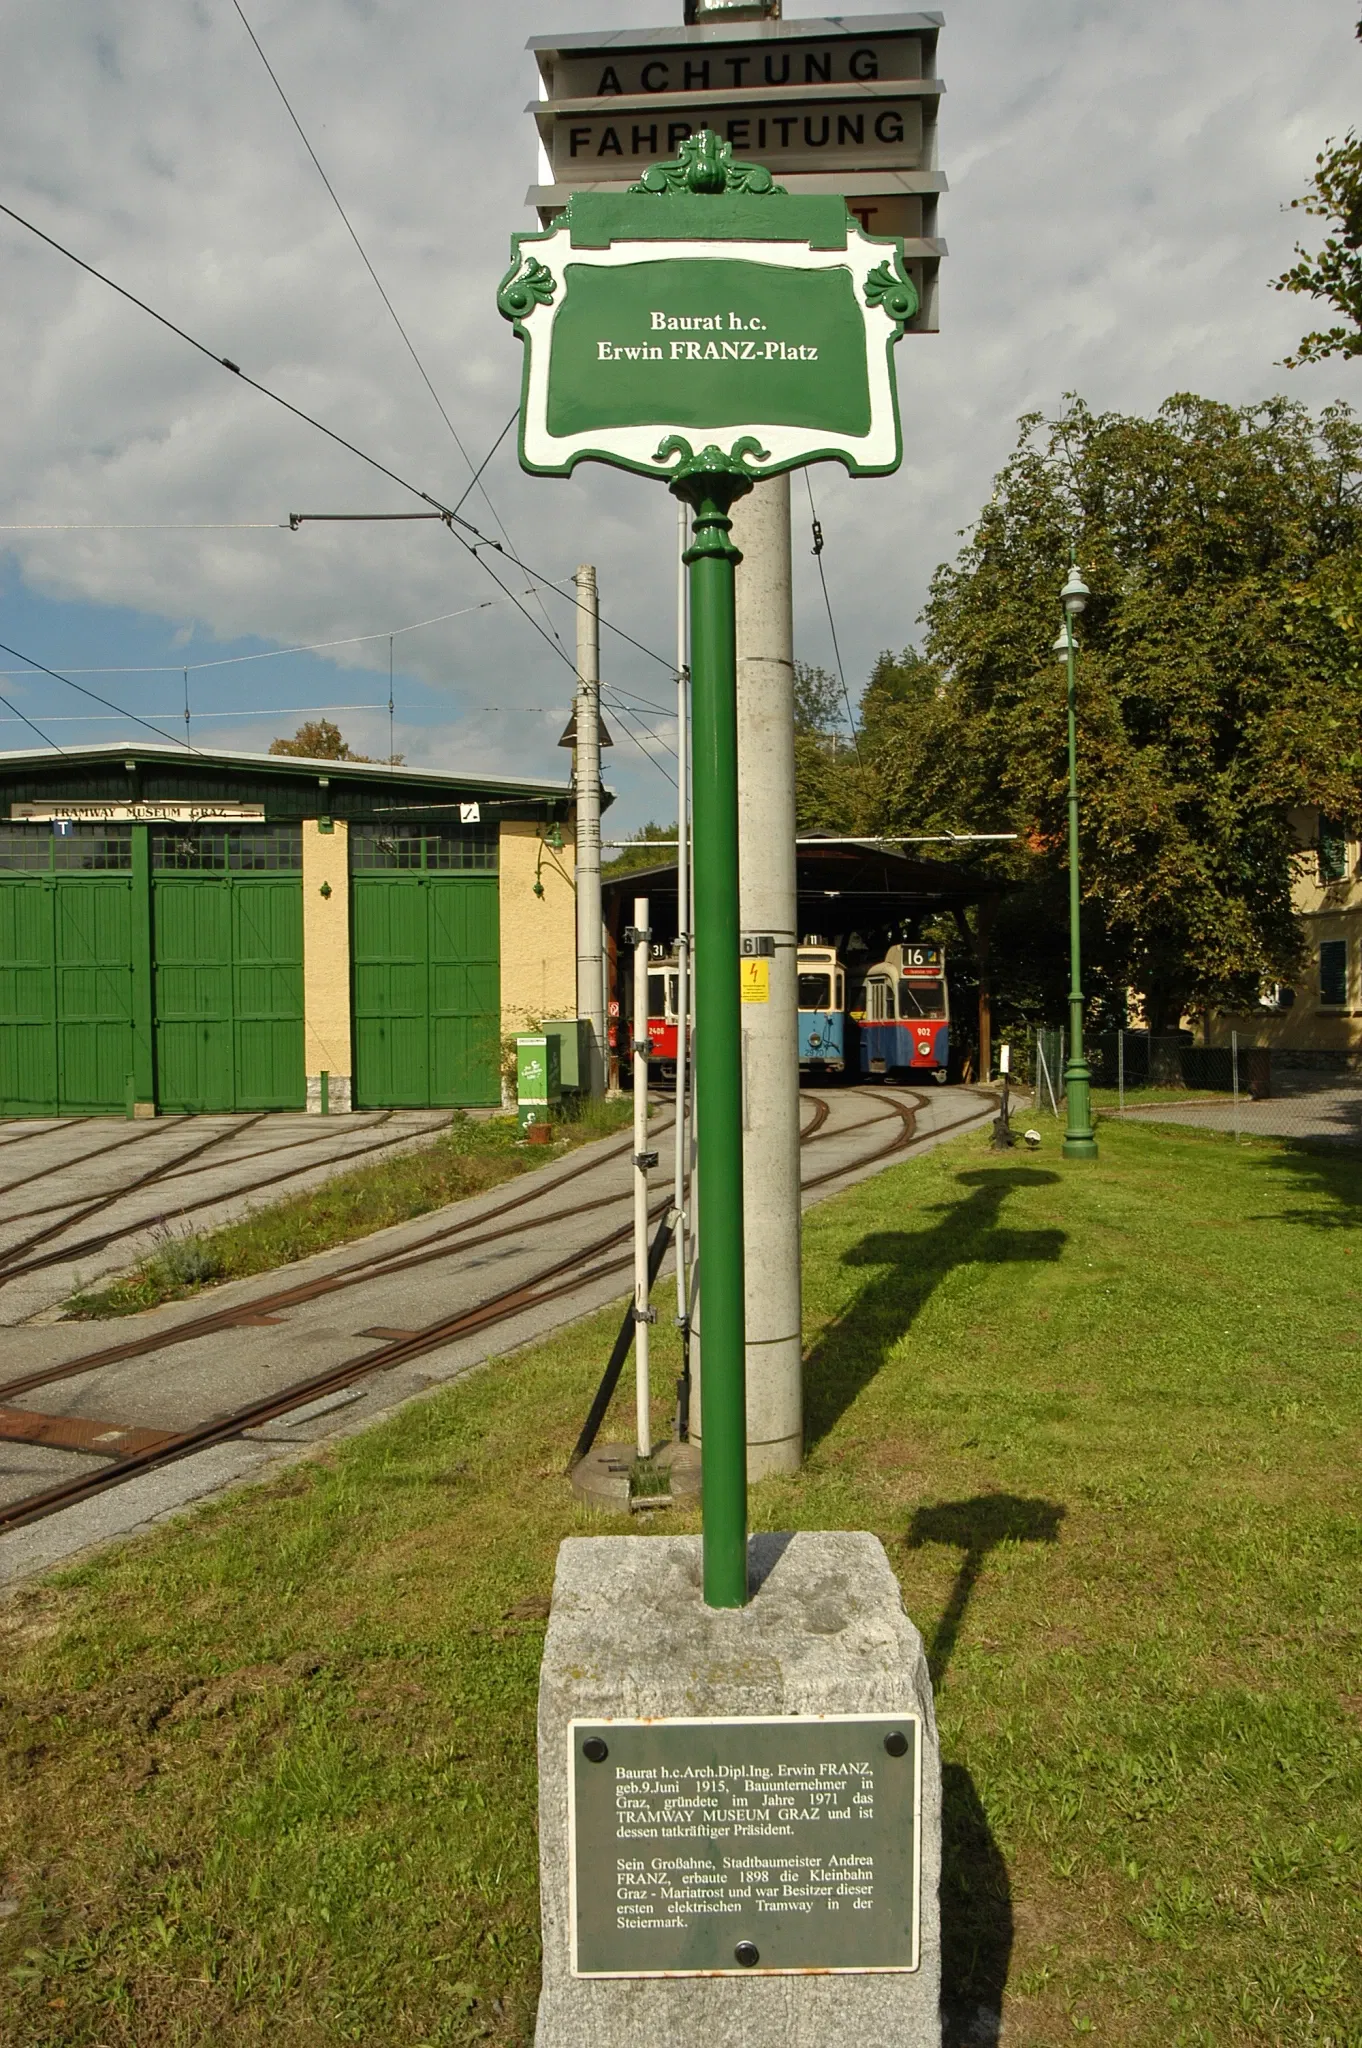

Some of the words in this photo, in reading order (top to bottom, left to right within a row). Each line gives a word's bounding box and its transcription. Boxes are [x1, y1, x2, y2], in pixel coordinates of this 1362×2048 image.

[597, 48, 879, 97] ACHTUNG
[569, 111, 904, 158] FAHREITUNG
[650, 311, 722, 331] Baurat
[728, 312, 767, 331] h.c.
[597, 341, 663, 361] Erwin
[669, 341, 818, 361] FRANZ-Platz
[53, 808, 116, 817] TRAMWAY
[126, 808, 181, 817] MUSEUM
[190, 808, 225, 818] GRAZ
[57, 821, 69, 835] T
[652, 945, 663, 956] 31
[907, 949, 924, 965] 16
[917, 1028, 931, 1036] 902
[616, 1767, 657, 1779] Baurat
[778, 1764, 815, 1776] Erwin
[820, 1762, 873, 1776] FRANZ,
[616, 1781, 679, 1796] geb.9.Juni
[696, 1781, 729, 1793] 1915,
[745, 1778, 847, 1791] Bauunternehmer
[861, 1777, 873, 1789] in
[616, 1797, 650, 1809] Graz,
[664, 1795, 718, 1810] gründete
[732, 1795, 748, 1806] im
[762, 1794, 795, 1806] Jahre
[810, 1793, 837, 1805] 1971
[853, 1792, 873, 1804] das
[616, 1810, 694, 1822] TRAMWAY
[703, 1809, 770, 1821] MUSEUM
[778, 1808, 820, 1820] GRAZ
[828, 1807, 850, 1819] und
[859, 1807, 873, 1818] ist
[616, 1826, 658, 1837] dessen
[662, 1824, 730, 1839] tatkräftiger
[734, 1823, 794, 1836] Präsident.
[617, 1858, 644, 1870] Sein
[651, 1857, 715, 1870] Großahne,
[723, 1855, 822, 1868] Stadtbaumeister
[828, 1854, 873, 1866] Andrea
[617, 1873, 671, 1885] FRANZ,
[682, 1872, 727, 1884] erbaute
[740, 1871, 769, 1882] 1898
[780, 1870, 799, 1882] die
[810, 1869, 873, 1881] Kleinbahn
[617, 1888, 647, 1899] Graz
[661, 1887, 724, 1899] Mariatrost
[728, 1886, 751, 1897] und
[756, 1888, 779, 1896] war
[783, 1884, 833, 1896] Besitzer
[837, 1883, 873, 1895] dieser
[617, 1904, 653, 1914] ersten
[668, 1901, 741, 1913] elektrischen
[756, 1900, 813, 1913] Tramway
[828, 1898, 839, 1909] in
[853, 1898, 873, 1909] der
[617, 1917, 688, 1928] Steiermark.
